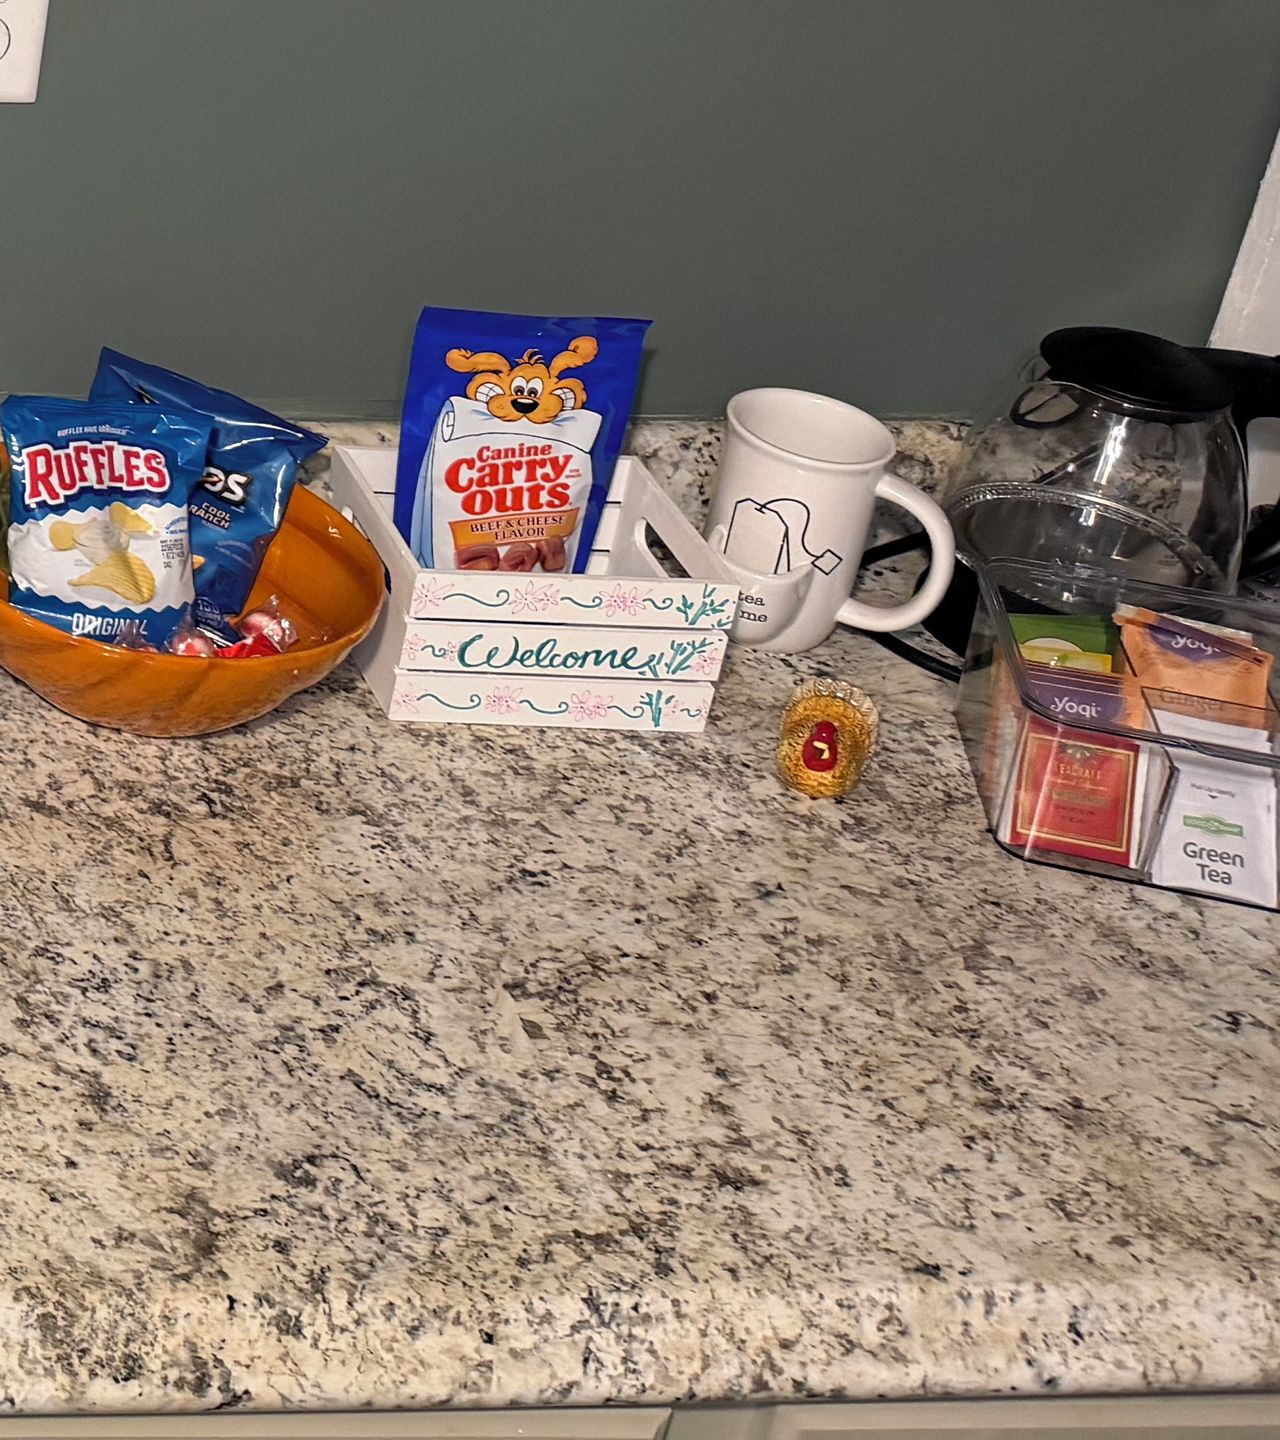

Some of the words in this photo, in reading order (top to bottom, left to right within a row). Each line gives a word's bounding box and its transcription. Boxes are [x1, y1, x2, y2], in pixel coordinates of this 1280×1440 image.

[57, 426, 83, 437] RUFFLES
[477, 443, 553, 462] Canine
[25, 442, 169, 504] RUFFLES
[444, 454, 573, 493] Carry
[189, 504, 230, 529] RANCH
[201, 502, 231, 521] COOL
[470, 522, 503, 533] BEEF
[517, 516, 566, 527] CHEESE
[495, 528, 545, 541] FLAVOR
[738, 591, 765, 606] tea
[458, 633, 653, 670] Welcome
[1172, 634, 1221, 655] yog
[1182, 841, 1245, 868] Green
[1196, 862, 1233, 885] Tea
